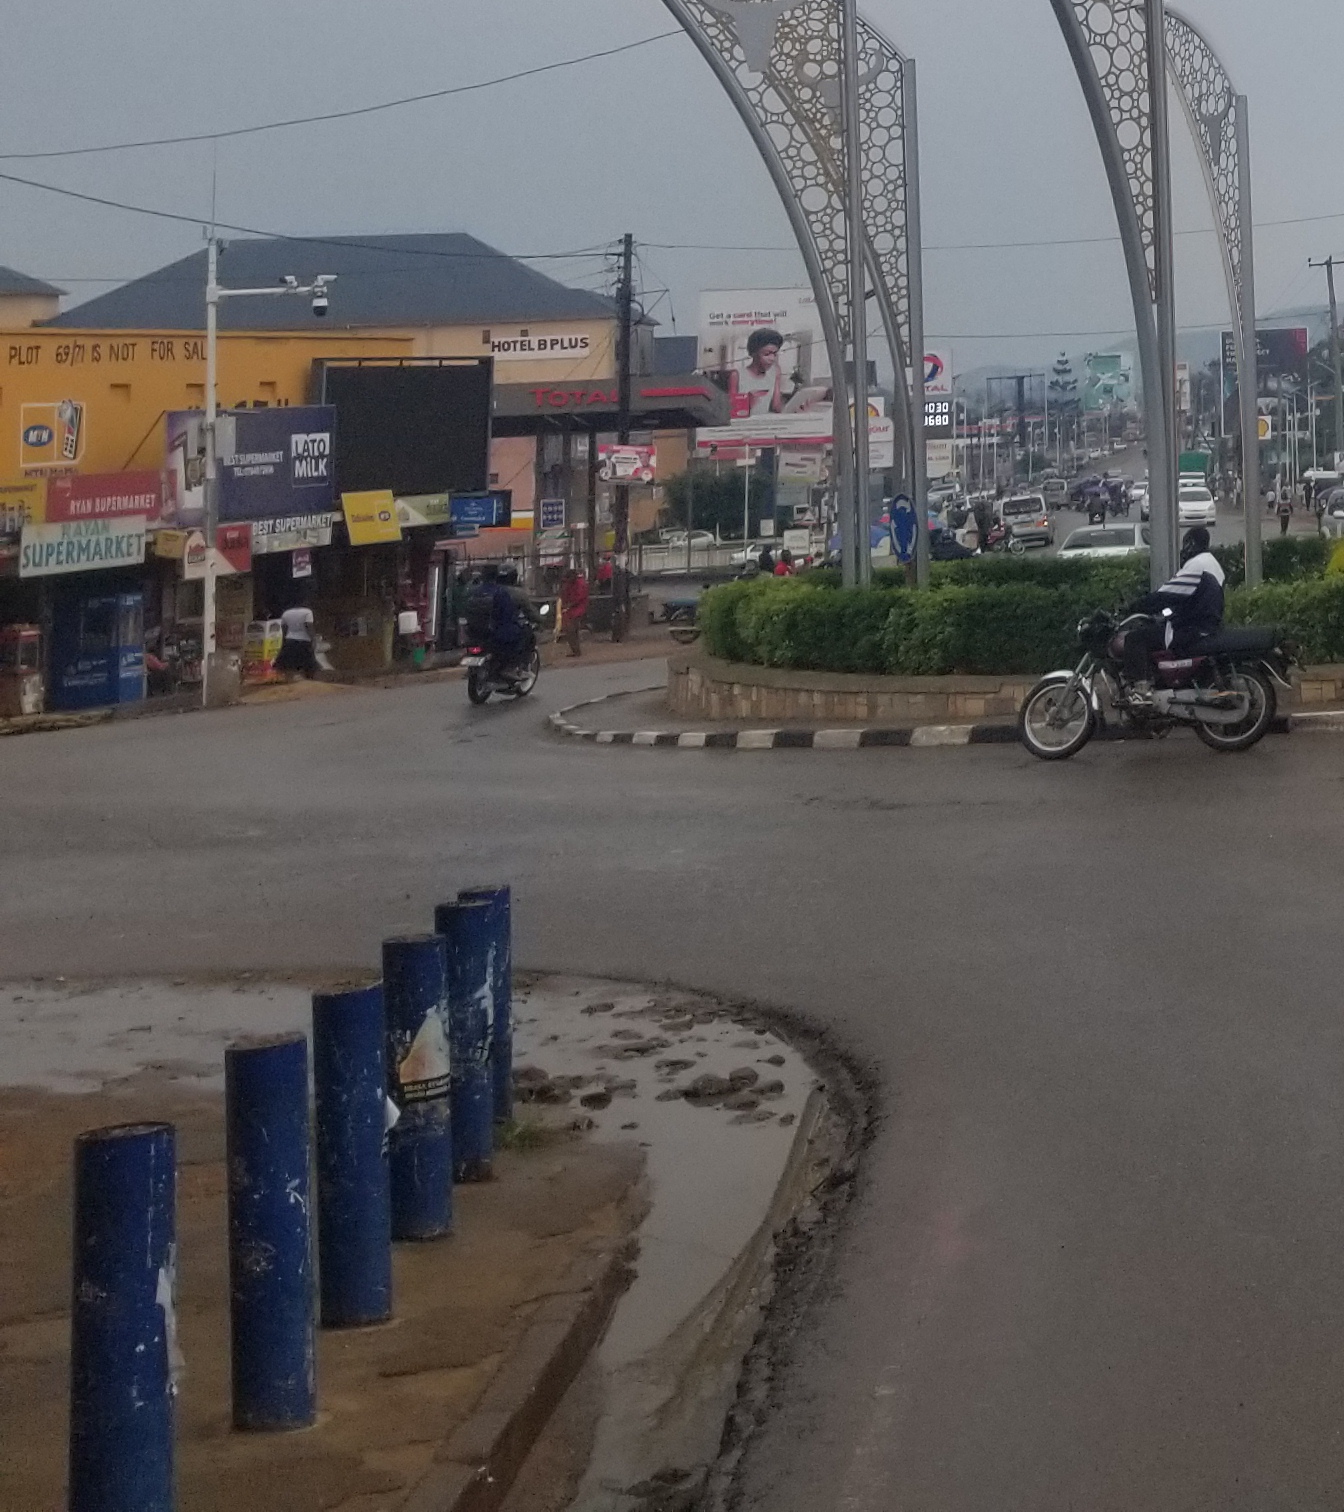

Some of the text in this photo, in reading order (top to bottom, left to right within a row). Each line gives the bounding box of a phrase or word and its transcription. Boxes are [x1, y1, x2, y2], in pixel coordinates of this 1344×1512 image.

[8, 345, 41, 366] PLOT
[91, 343, 101, 362] IS
[109, 342, 137, 362] NOT
[151, 341, 175, 361] FOR
[184, 341, 208, 361] SAL
[491, 337, 589, 352] HOTEL B PLUS
[294, 438, 327, 457] LATO
[69, 494, 156, 515] RYAN SUPERMARKET
[252, 520, 274, 535] BEST
[275, 514, 332, 533] SUPERMARKET
[22, 533, 145, 570] SUPERMARKET
